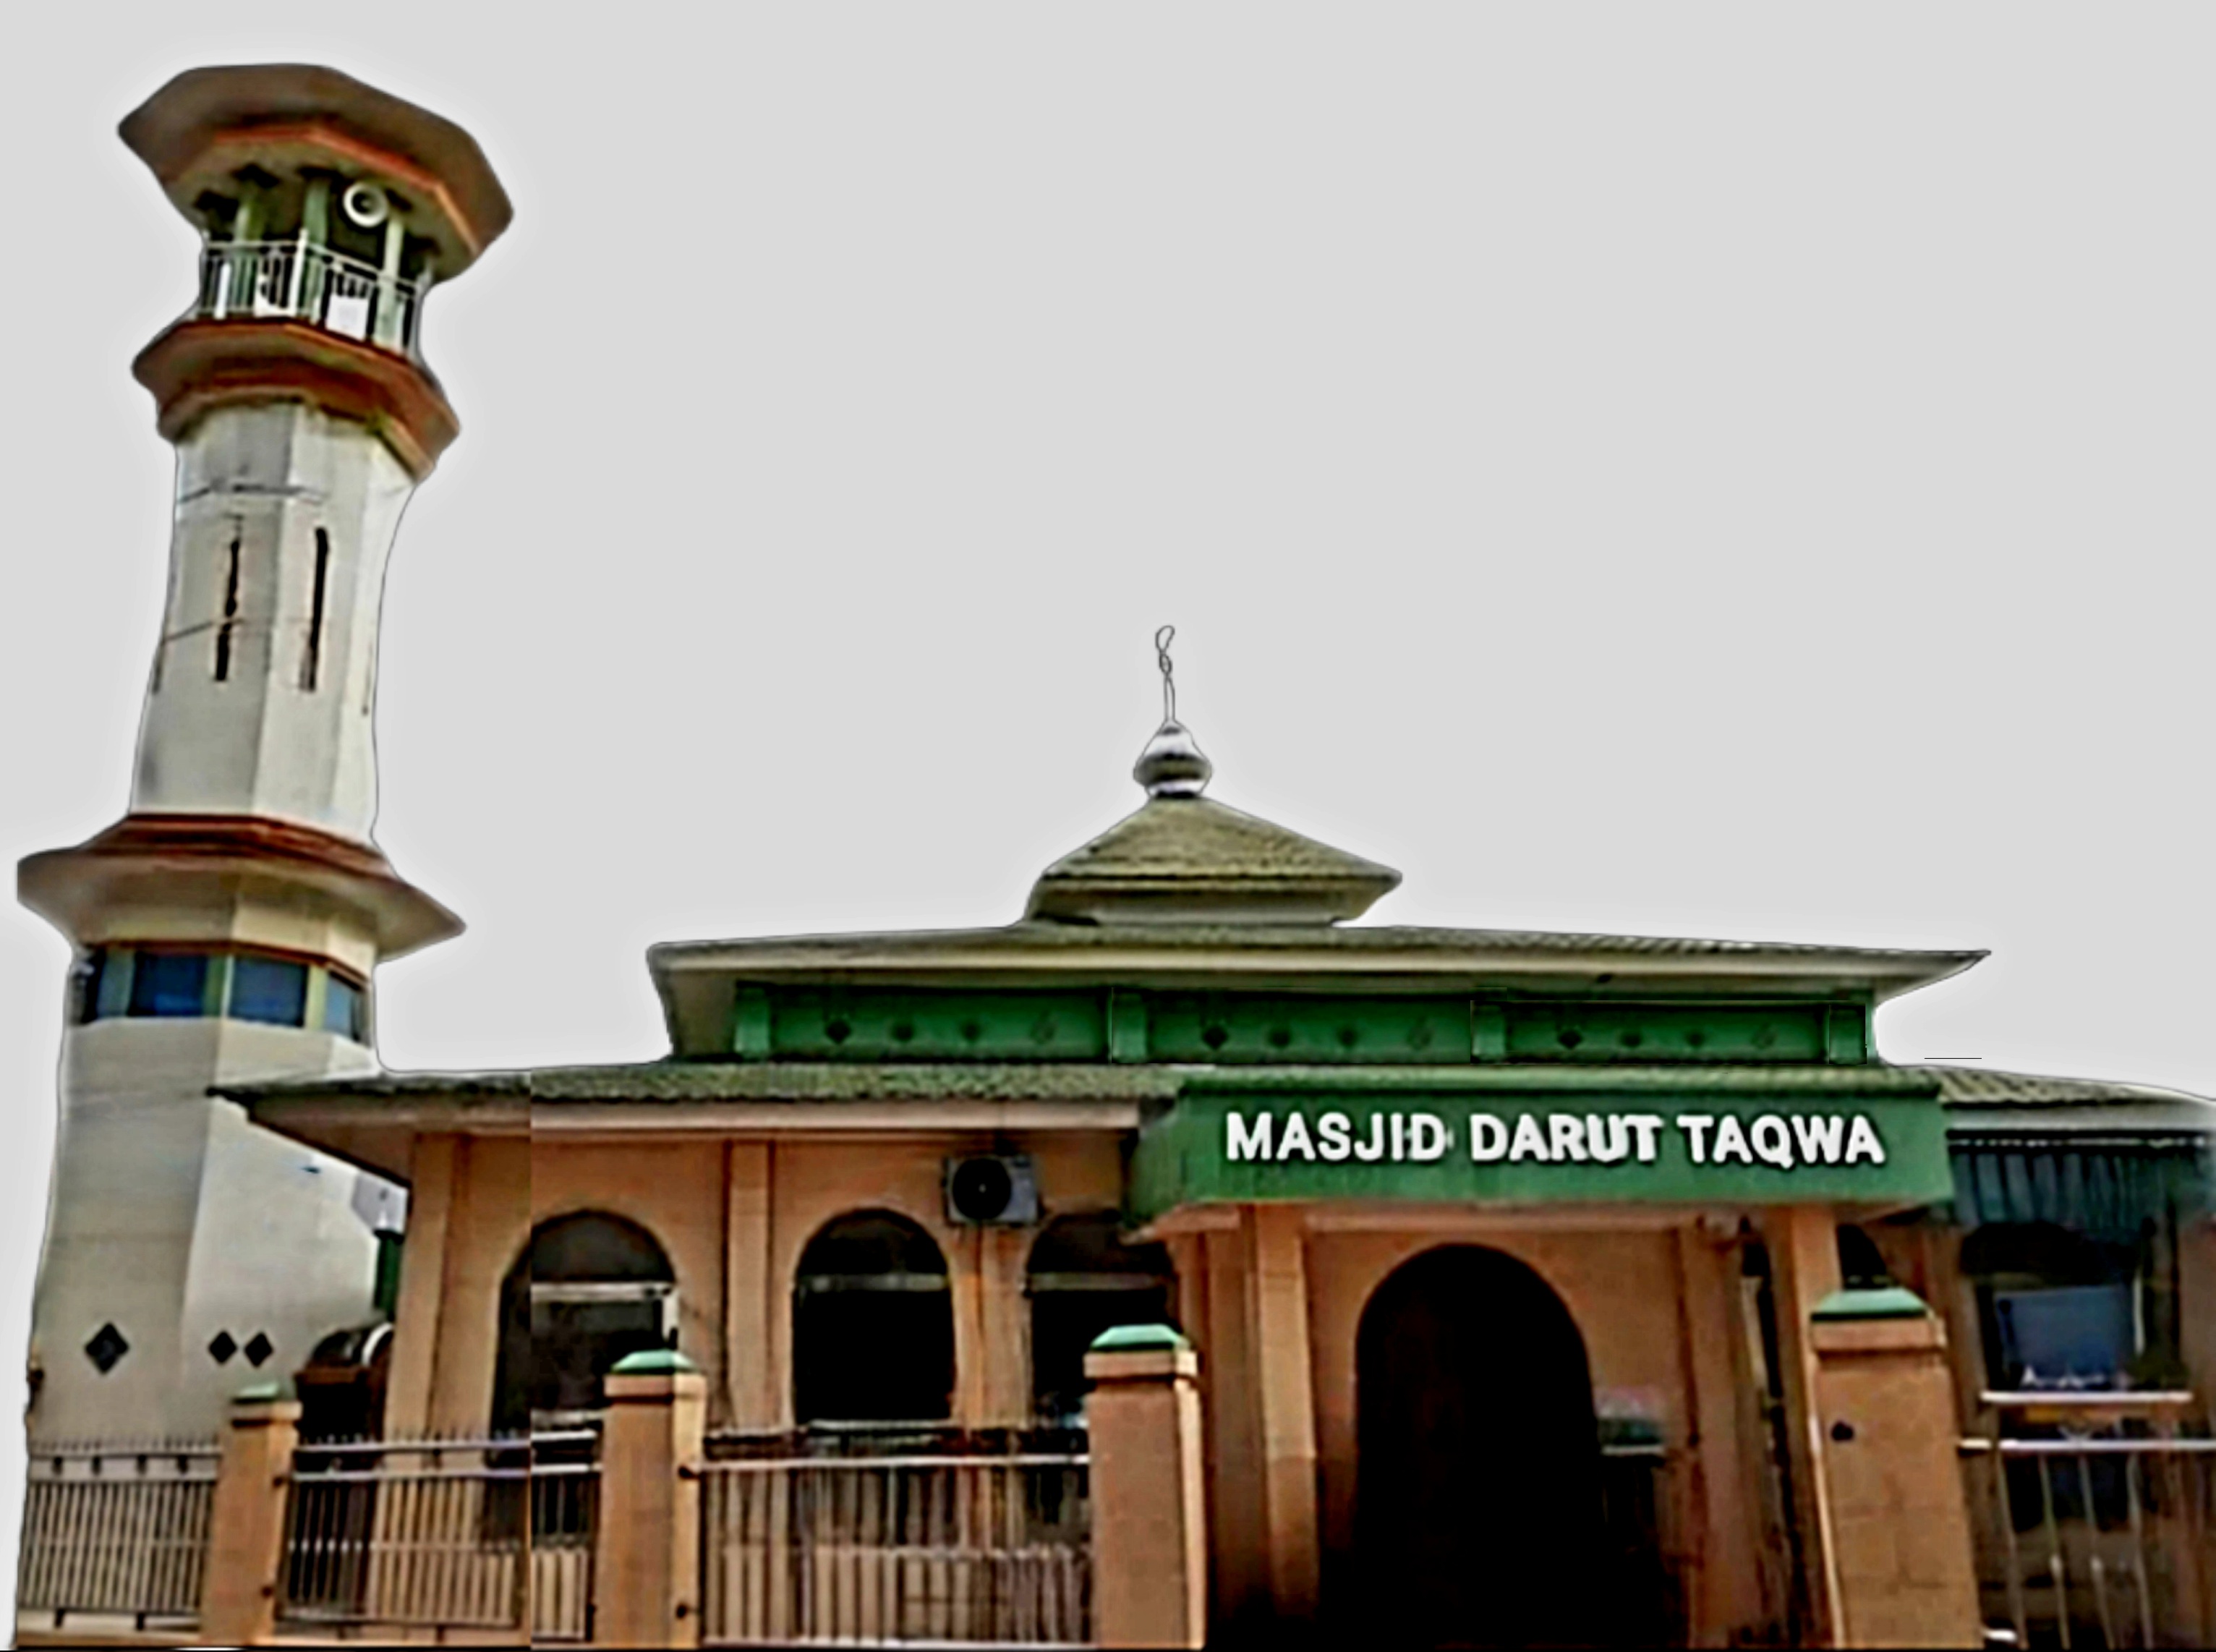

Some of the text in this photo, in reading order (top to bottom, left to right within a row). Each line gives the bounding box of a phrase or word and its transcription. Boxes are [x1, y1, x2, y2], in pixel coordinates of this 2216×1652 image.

[1226, 1111, 1886, 1169] MASJID DARUT TAQWA
